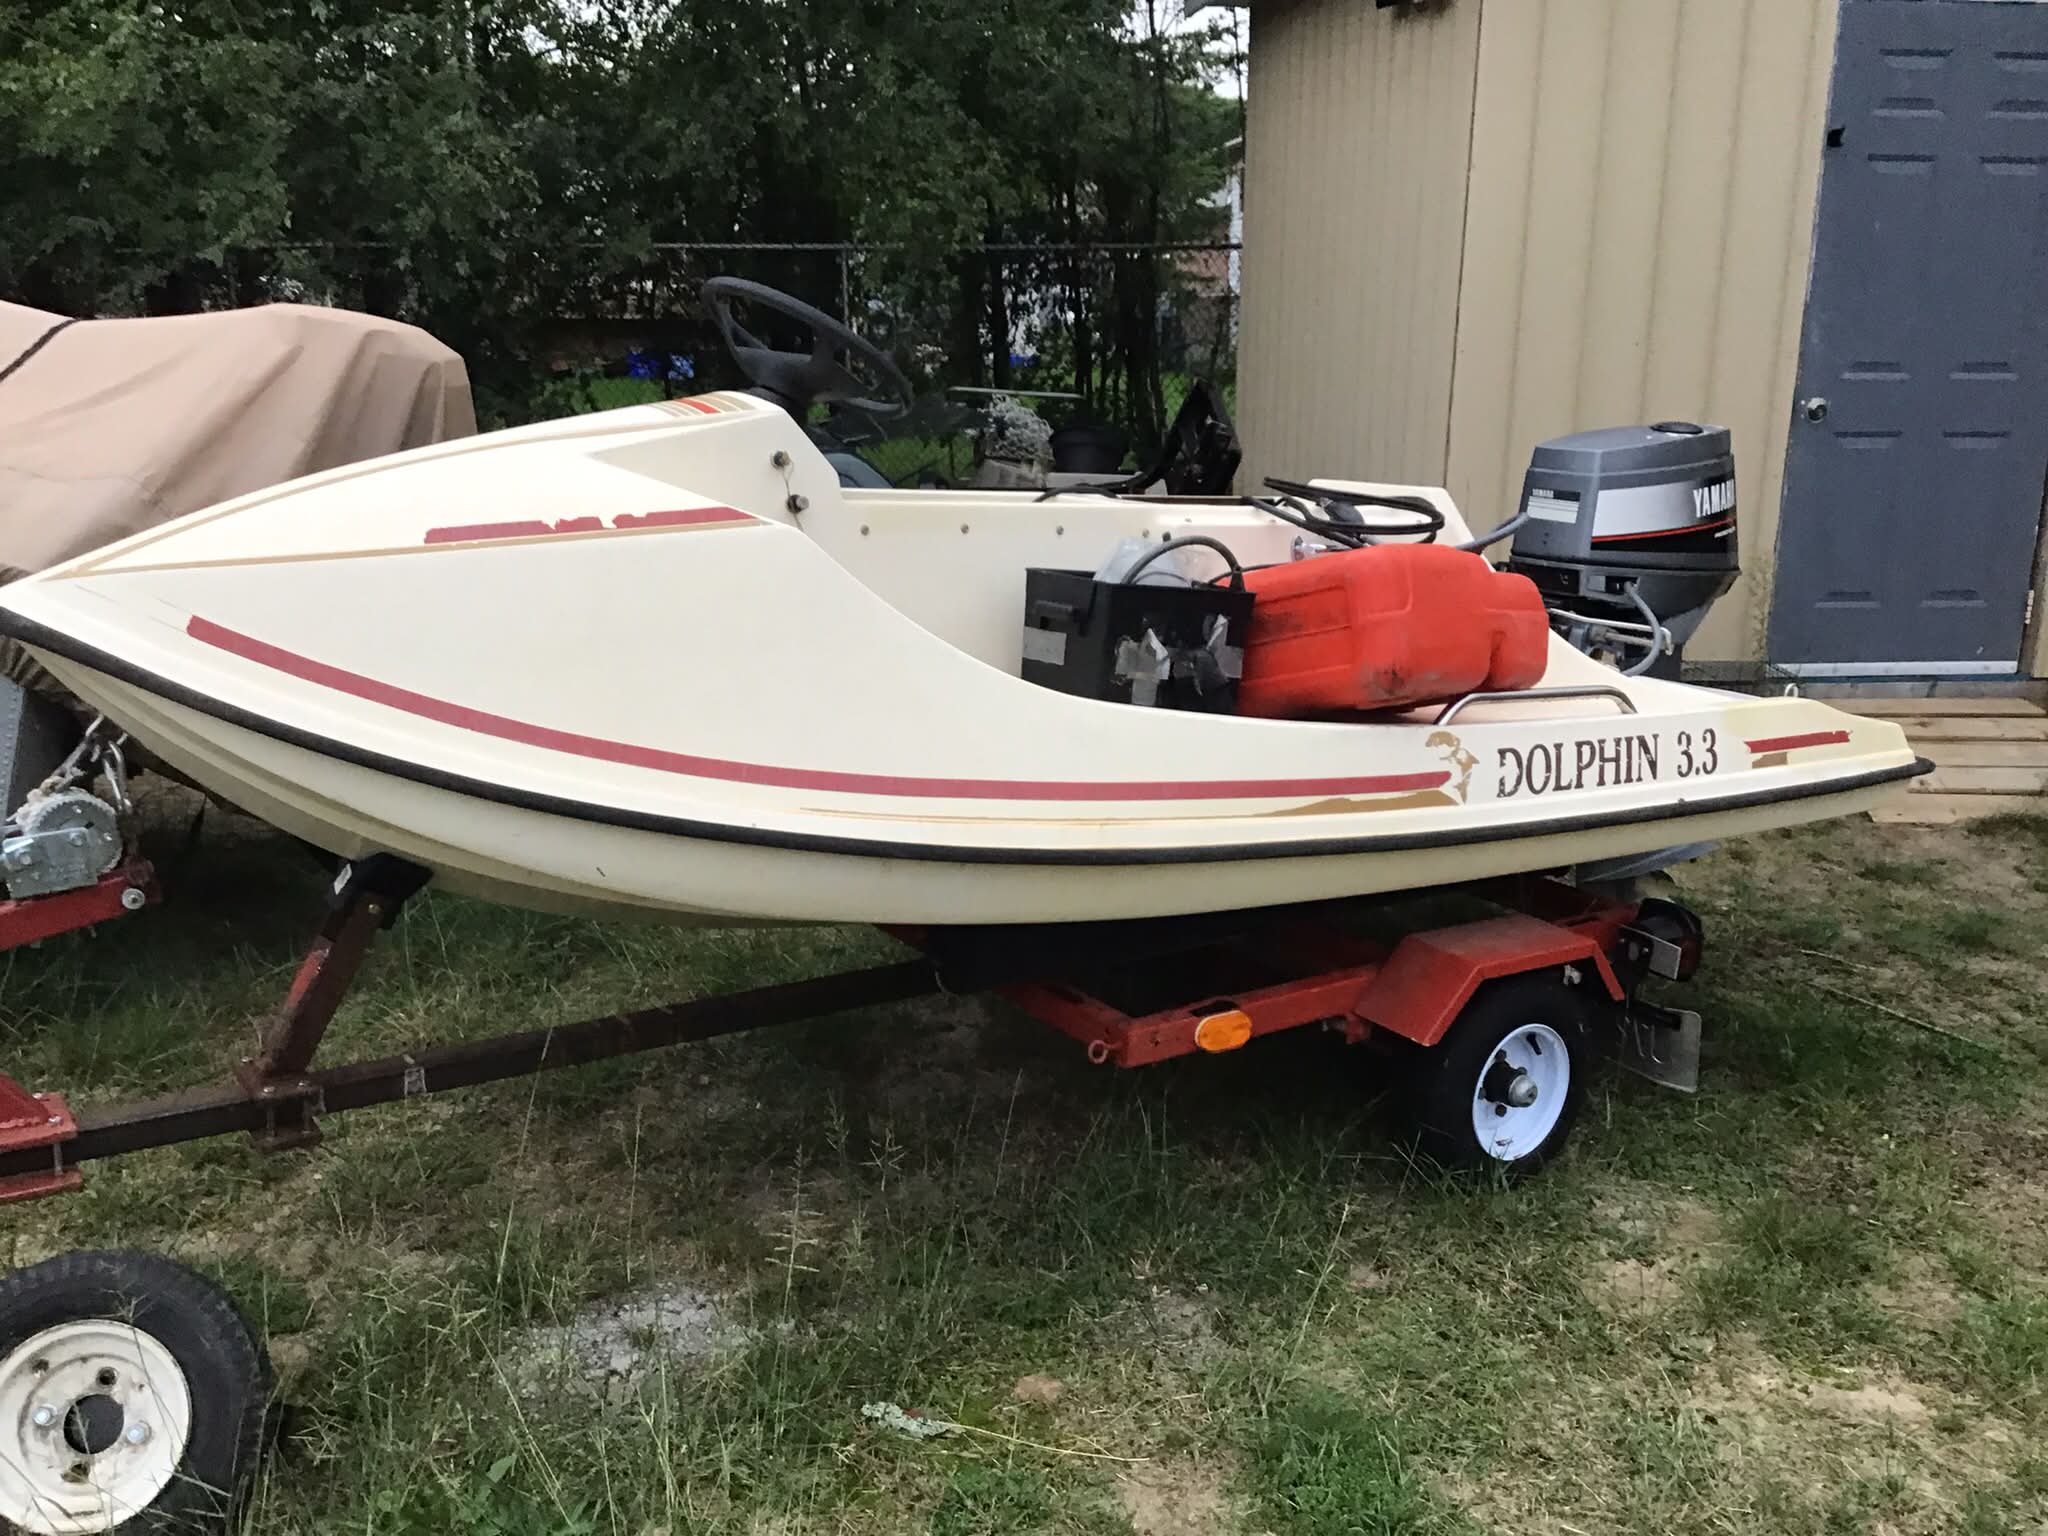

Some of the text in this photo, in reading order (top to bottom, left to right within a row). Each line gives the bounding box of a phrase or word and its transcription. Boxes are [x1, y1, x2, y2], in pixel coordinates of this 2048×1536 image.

[1693, 479, 1735, 518] YAMAH
[1497, 728, 1718, 798] DOLPHIN 3.3
